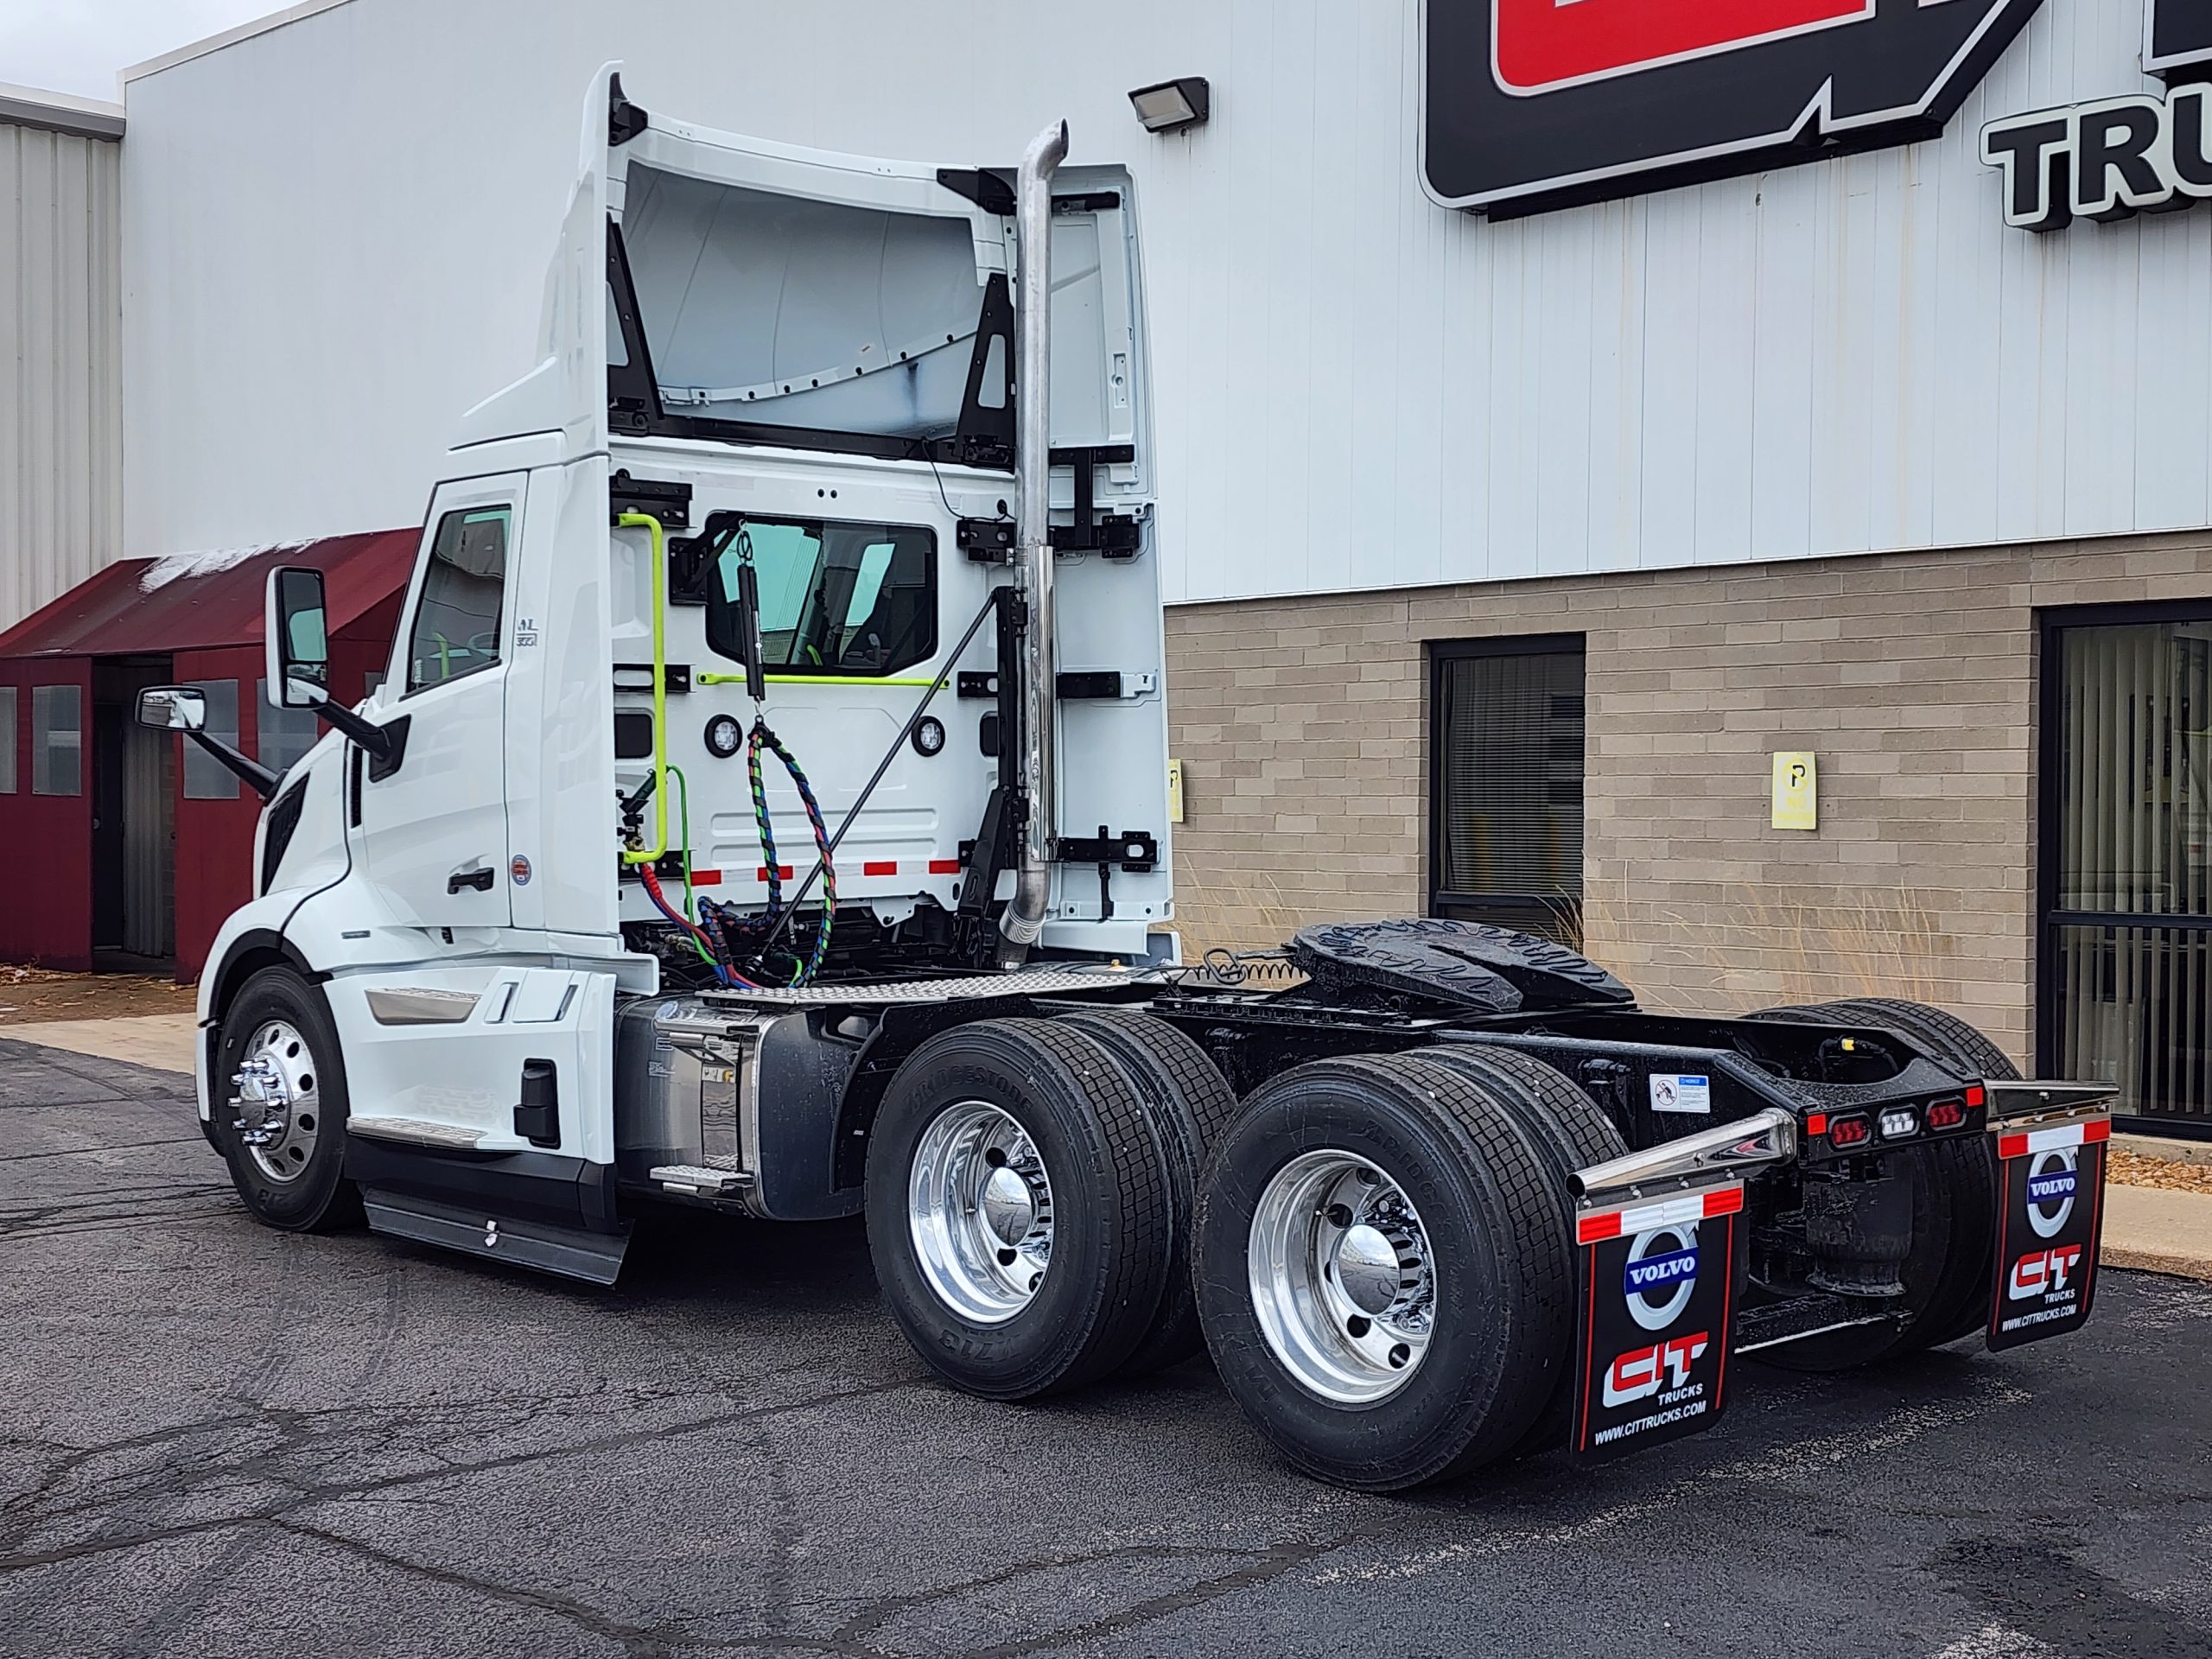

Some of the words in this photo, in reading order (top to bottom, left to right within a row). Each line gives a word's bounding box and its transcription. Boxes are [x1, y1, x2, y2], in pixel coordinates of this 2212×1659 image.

[1791, 764, 1806, 787] P
[2030, 1176, 2076, 1198] VOLVO
[1629, 1255, 1697, 1286] VOLVO
[2009, 1243, 2083, 1301] CIT
[2044, 1288, 2076, 1305] TRUCKS
[2001, 1304, 2077, 1332] WWW.CITTRUCKS.COM
[1603, 1331, 1708, 1408] CIT
[1657, 1382, 1704, 1407] TRUCKS
[1594, 1400, 1707, 1446] WWW.CITTRUCKS.COM
